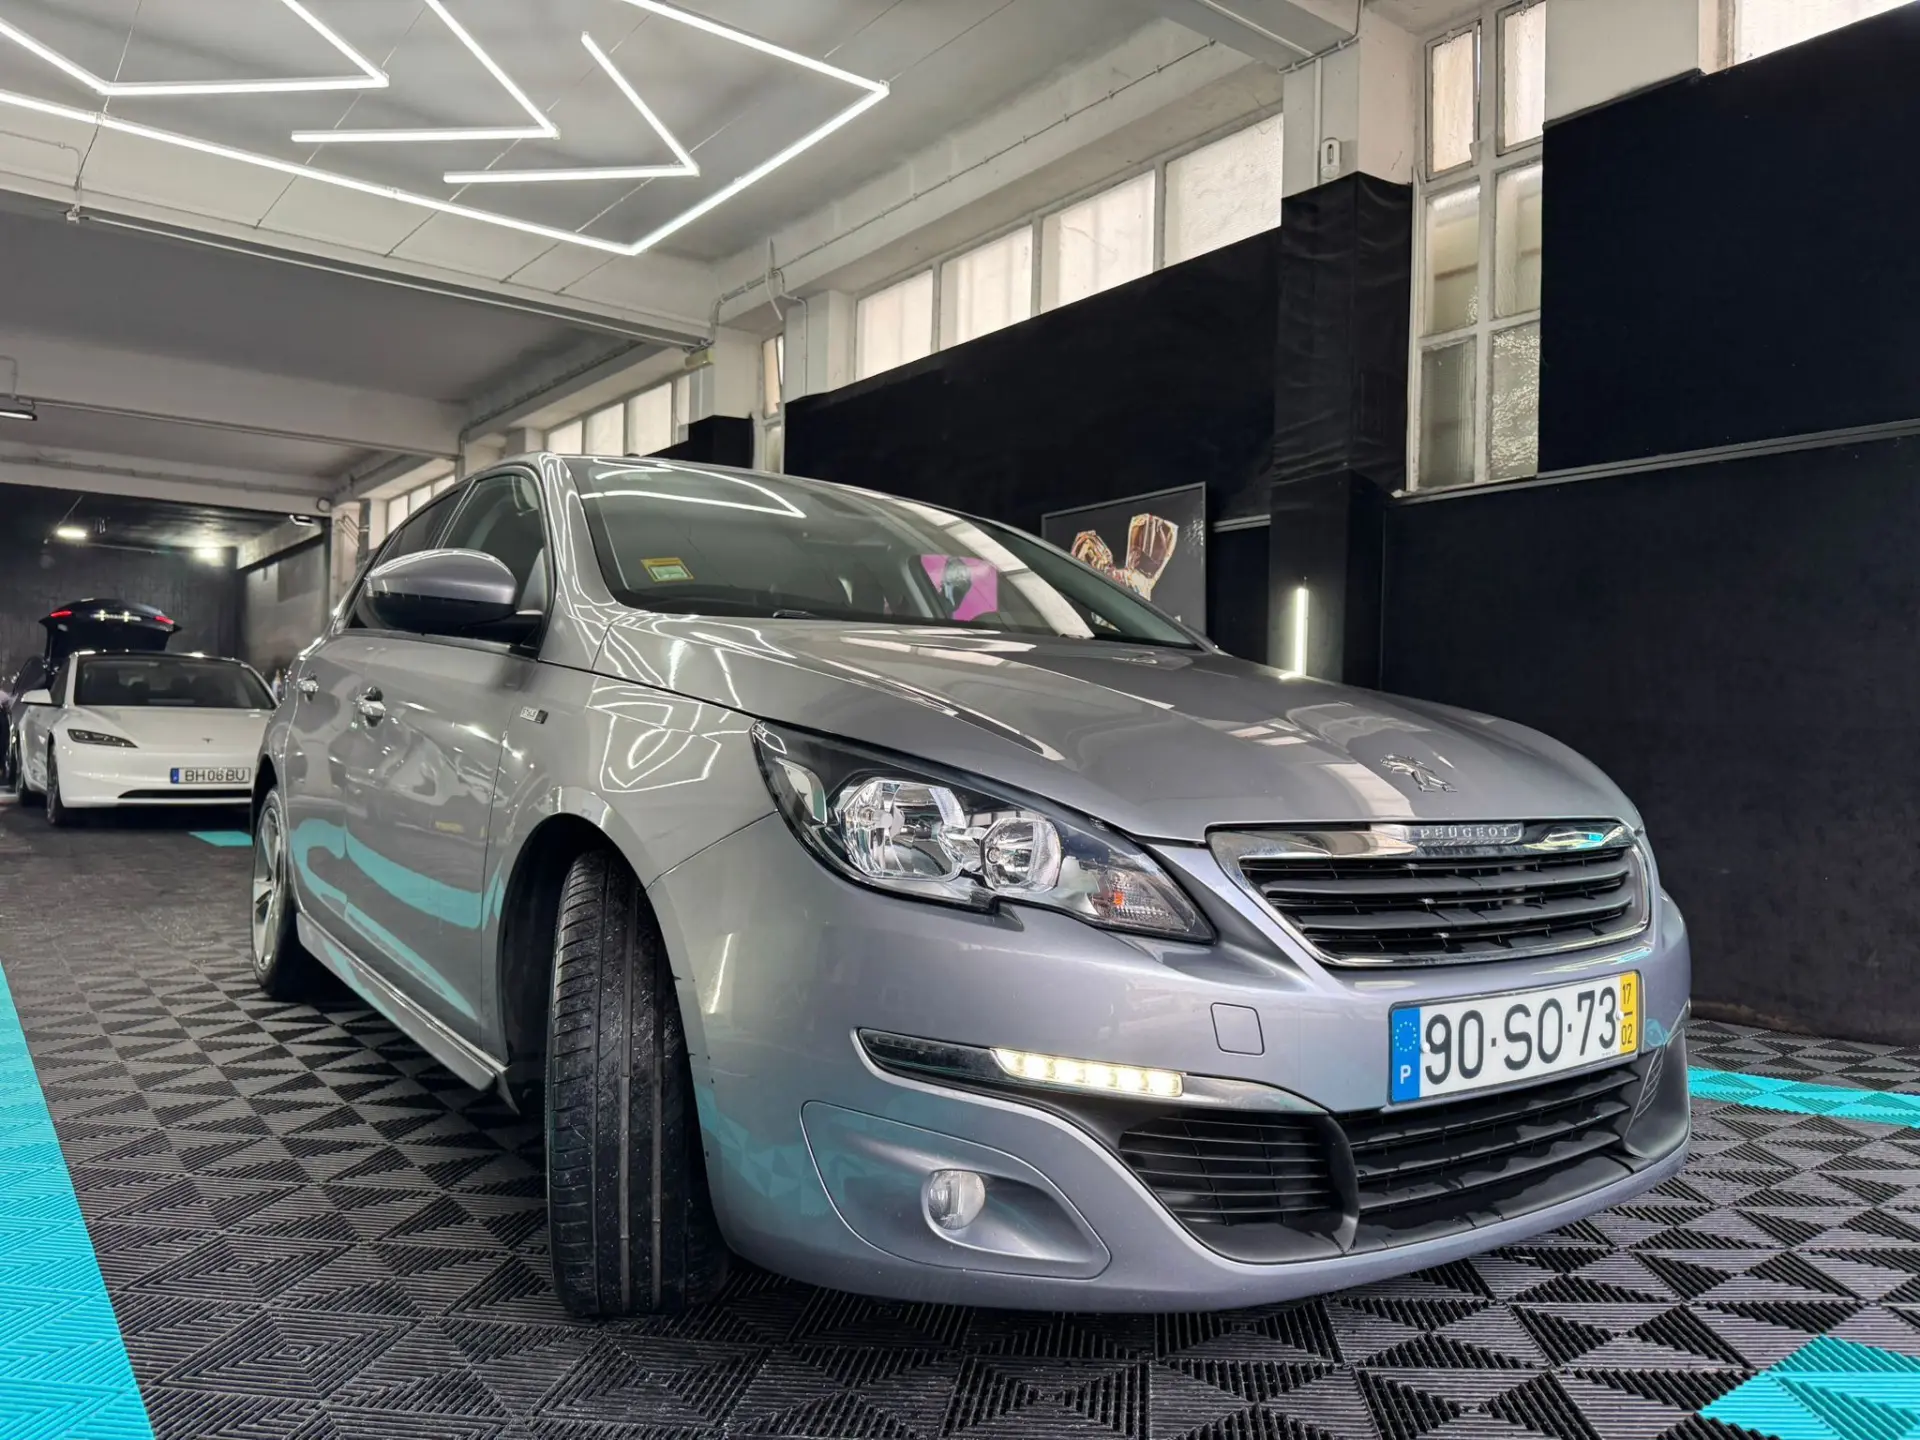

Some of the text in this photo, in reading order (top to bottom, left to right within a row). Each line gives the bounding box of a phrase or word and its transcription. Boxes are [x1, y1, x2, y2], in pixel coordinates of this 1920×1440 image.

[1420, 826, 1510, 839] PEUGEOT
[1622, 983, 1632, 1005] 17
[1621, 1023, 1632, 1046] 02
[1400, 1064, 1411, 1085] P
